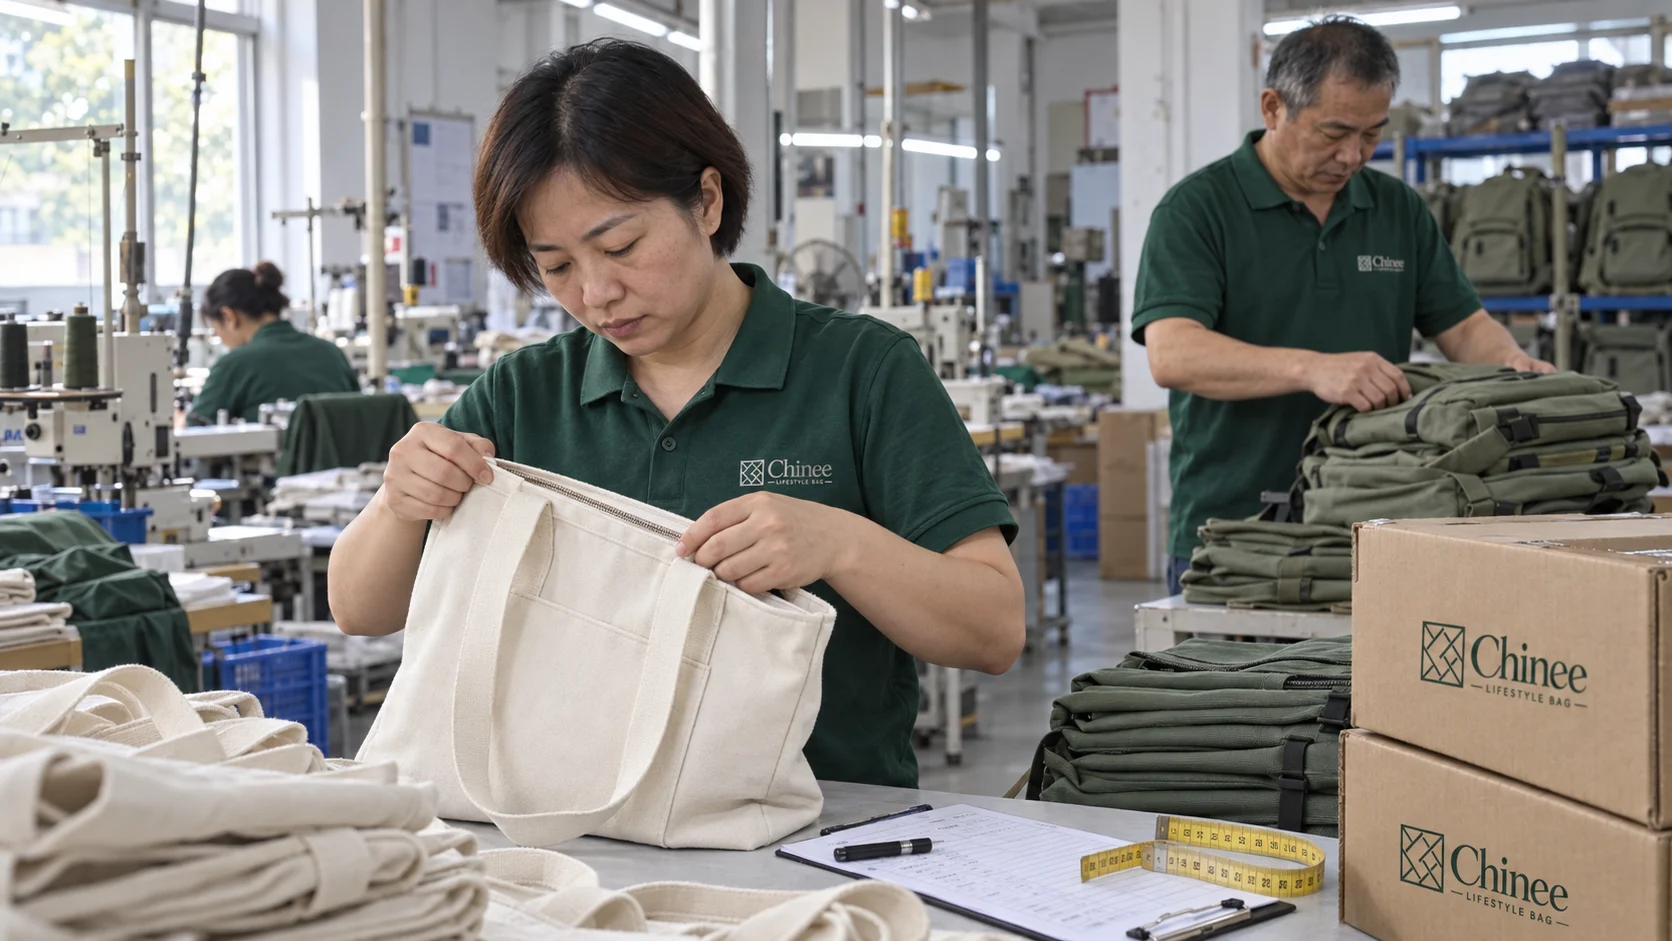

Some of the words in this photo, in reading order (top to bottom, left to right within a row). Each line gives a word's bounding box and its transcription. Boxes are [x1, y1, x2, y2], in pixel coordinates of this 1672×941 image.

[1372, 255, 1404, 268] Chinee
[768, 459, 833, 479] Chinee
[1471, 634, 1588, 694] Chinee
[1486, 684, 1544, 704] LIFESTYLE
[1549, 695, 1571, 708] BAG
[1450, 844, 1569, 912] Chinee
[1466, 892, 1524, 916] LIFESTYLE
[1530, 909, 1553, 925] BAG
